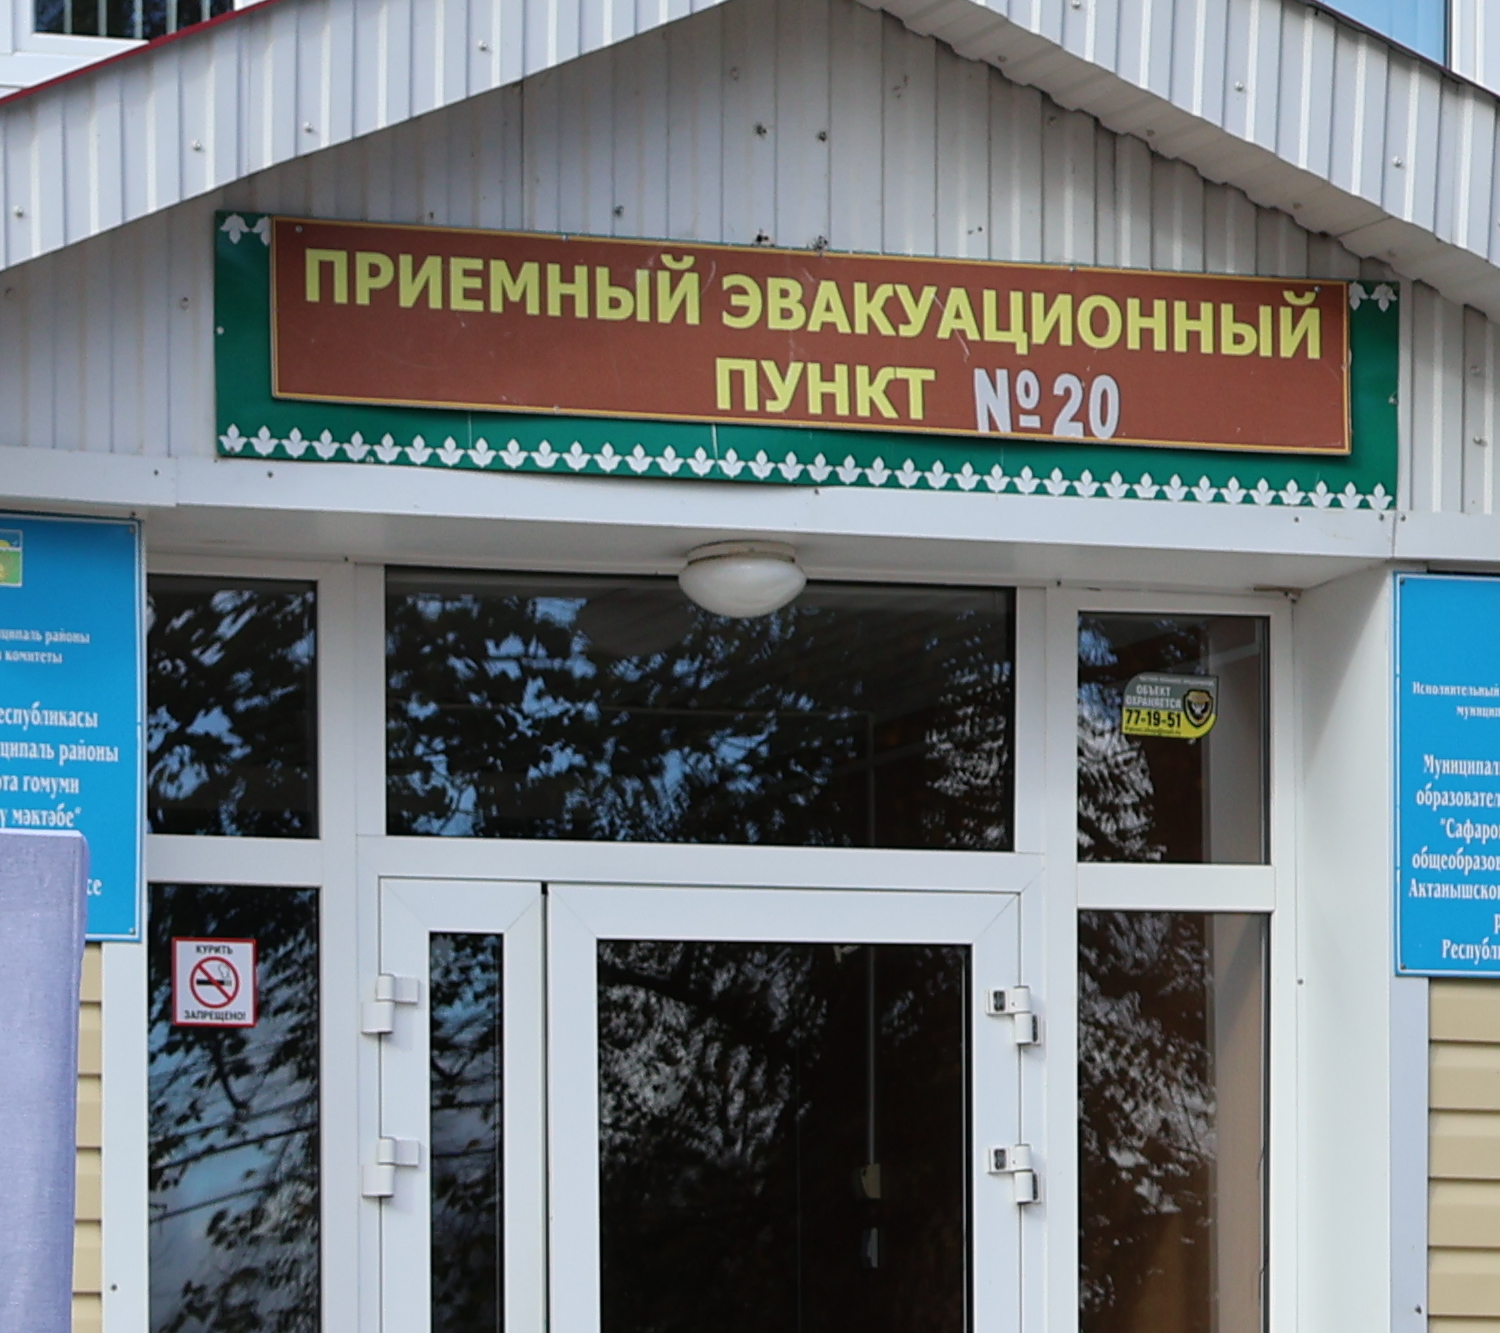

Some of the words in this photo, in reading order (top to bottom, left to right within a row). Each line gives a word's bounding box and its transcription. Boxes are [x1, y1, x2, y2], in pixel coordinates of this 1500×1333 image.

[305, 248, 699, 327] ПРИЕМНЫЙ
[722, 272, 1320, 359] ЭВАКУАЦИОННЫЙ
[716, 358, 935, 419] ПУНКТ
[45, 627, 91, 645] районы
[5, 649, 63, 665] комитеты
[1136, 684, 1172, 697] ОБЪЕКТ
[1412, 681, 1500, 698] Исполнительный
[1125, 695, 1182, 709] ОХРАНЯЕТСЯ
[1125, 709, 1182, 728] 77-19-51
[59, 739, 119, 766] районы
[22, 776, 79, 800] гомуми
[196, 945, 234, 955] КУРИТЬ
[184, 1009, 247, 1022] ЗАПРЕЩЕНО!
